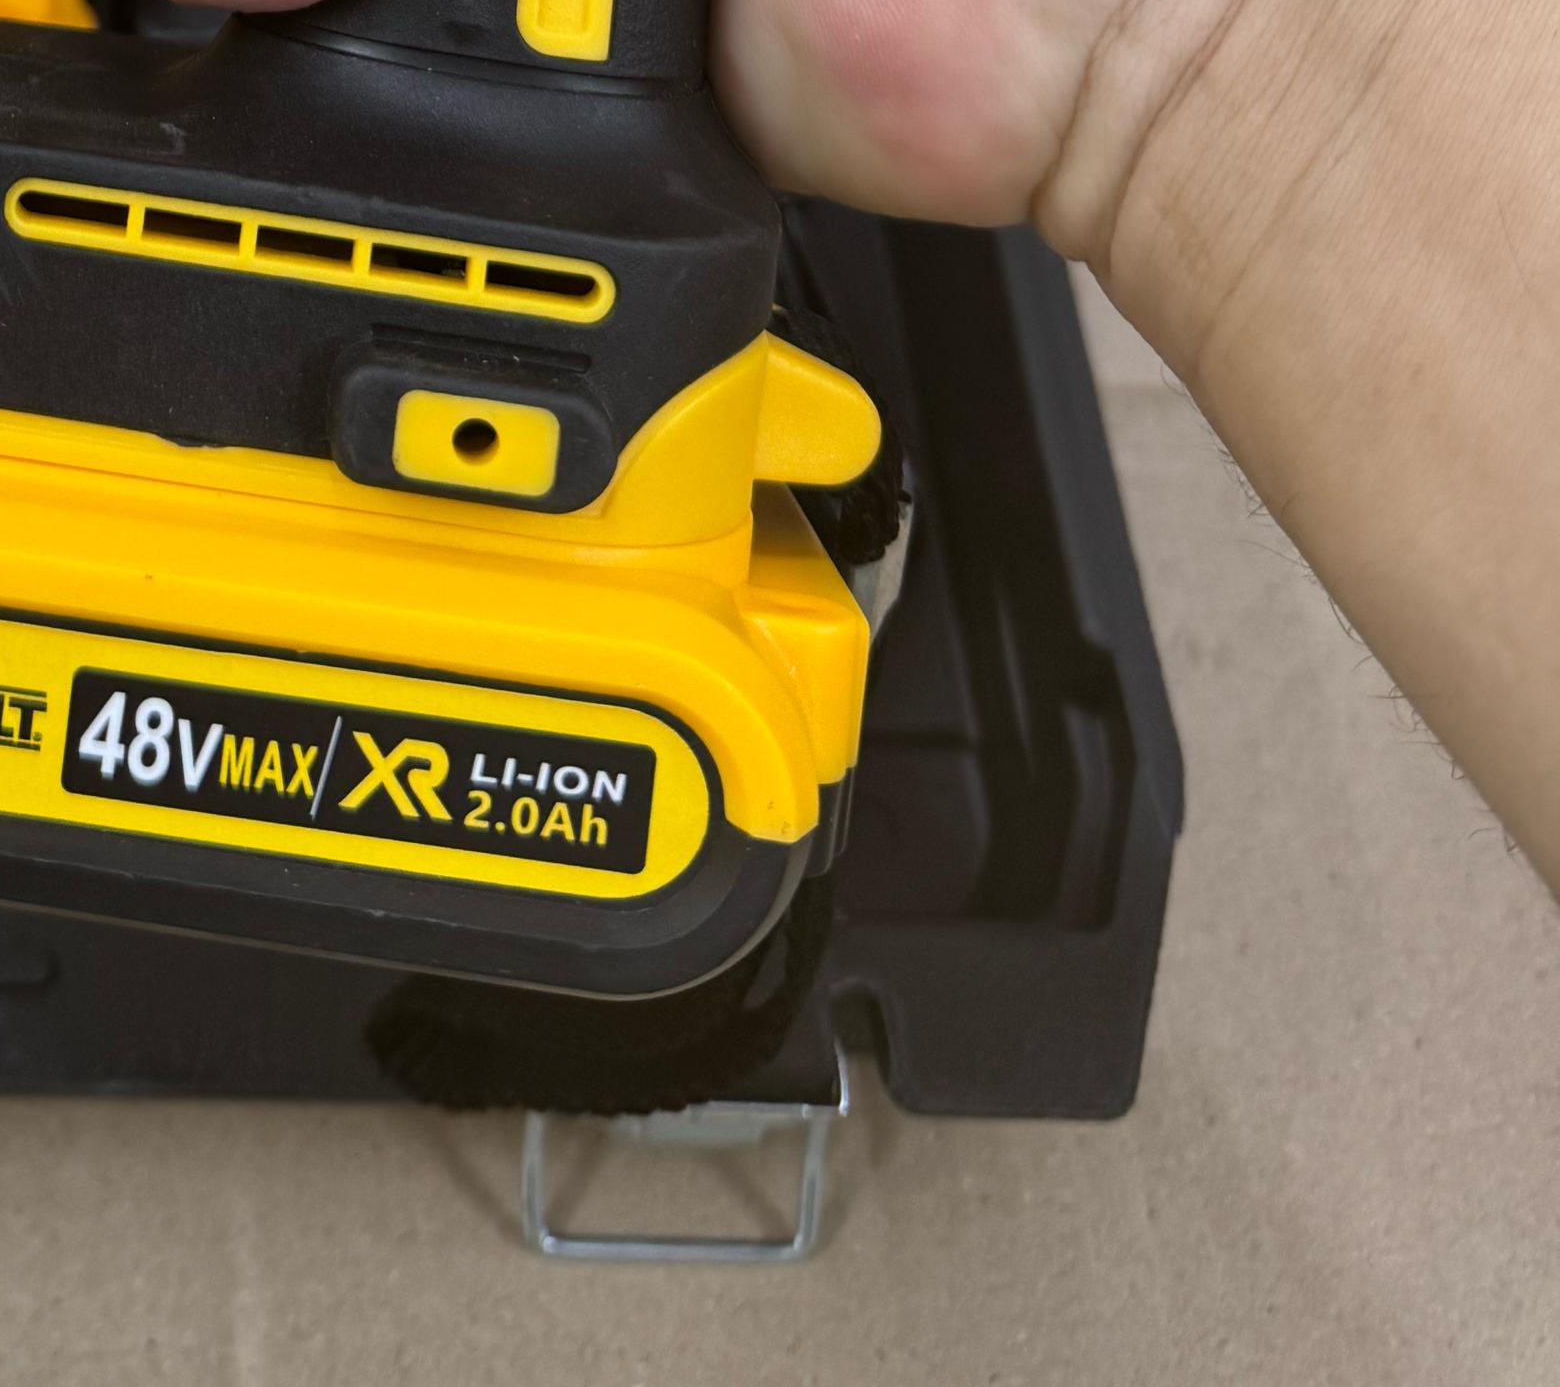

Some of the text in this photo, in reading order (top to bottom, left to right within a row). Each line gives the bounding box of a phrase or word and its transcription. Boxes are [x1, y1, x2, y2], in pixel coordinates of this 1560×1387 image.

[337, 729, 454, 823] XR
[470, 752, 628, 805] LI-ION
[463, 789, 610, 848] 2.0Ah
